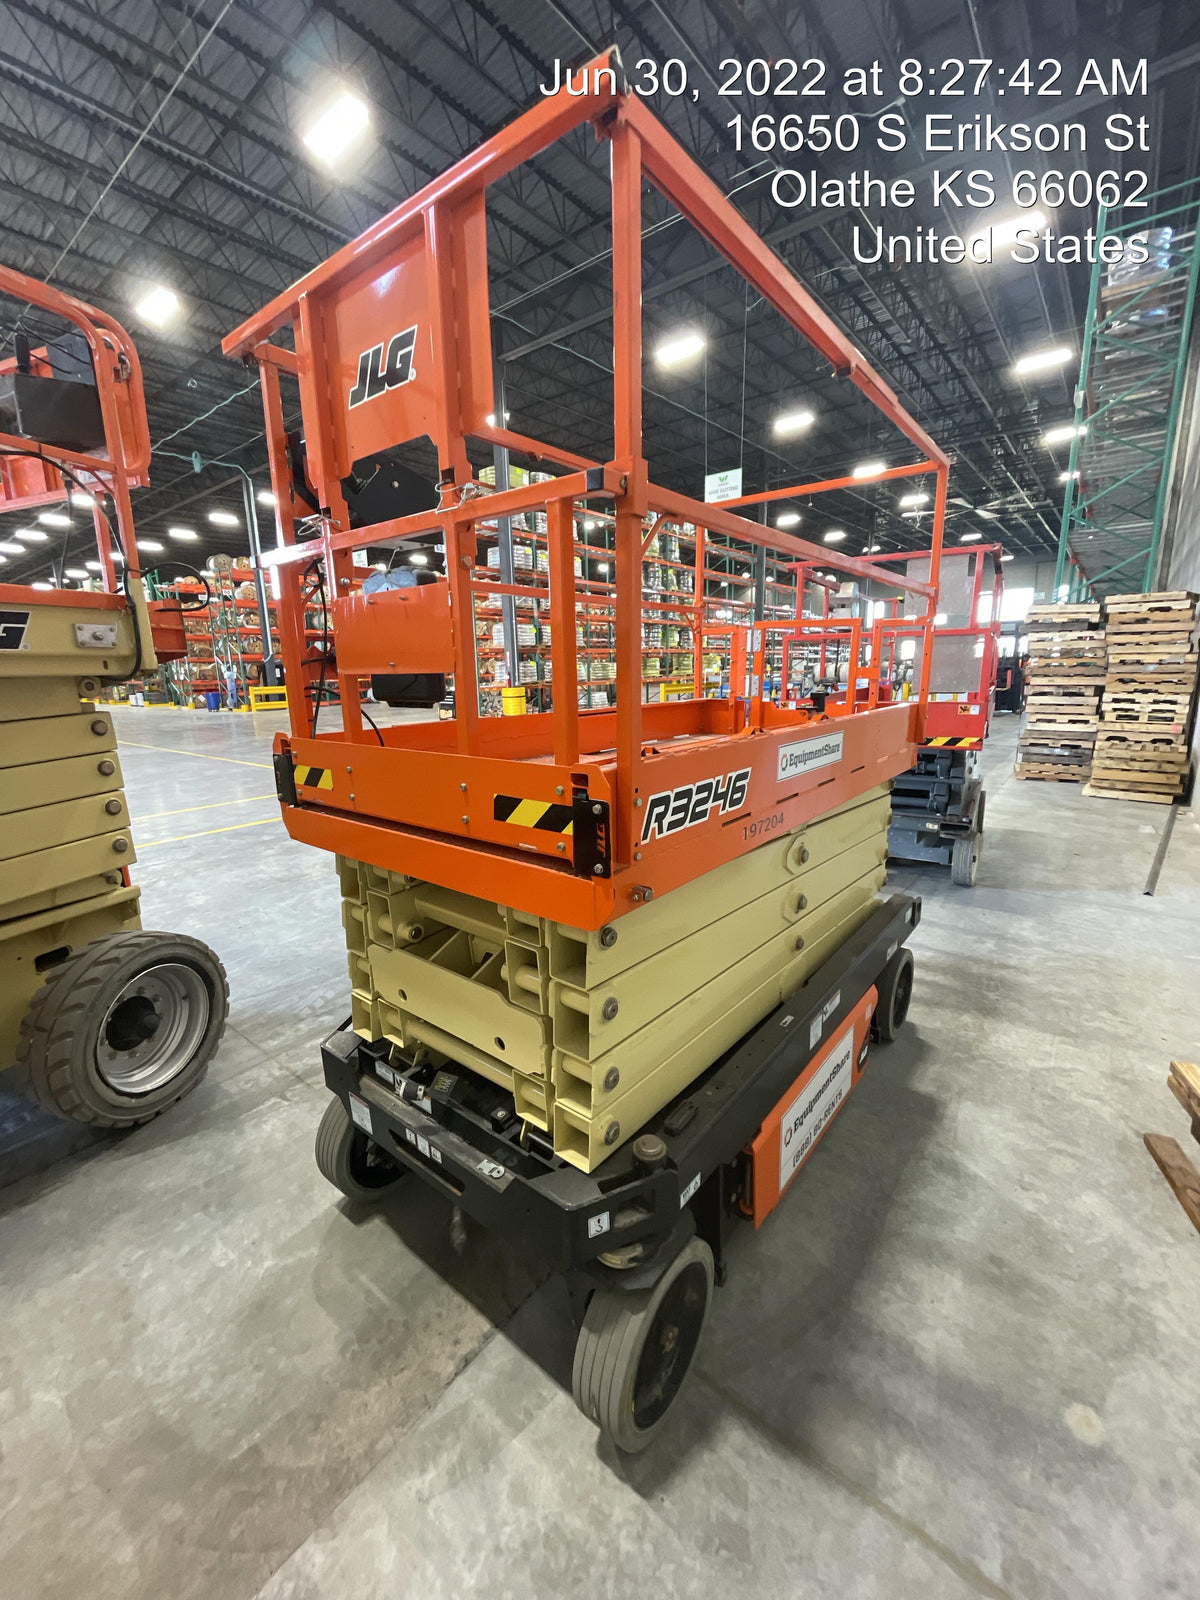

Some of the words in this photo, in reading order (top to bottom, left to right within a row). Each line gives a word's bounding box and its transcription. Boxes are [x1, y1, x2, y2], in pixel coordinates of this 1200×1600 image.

[349, 324, 417, 409] JLG
[788, 743, 841, 768] EquipmentShare
[641, 767, 752, 845] R3246
[742, 812, 785, 841] 197204
[793, 1049, 851, 1134] EquipmentShare
